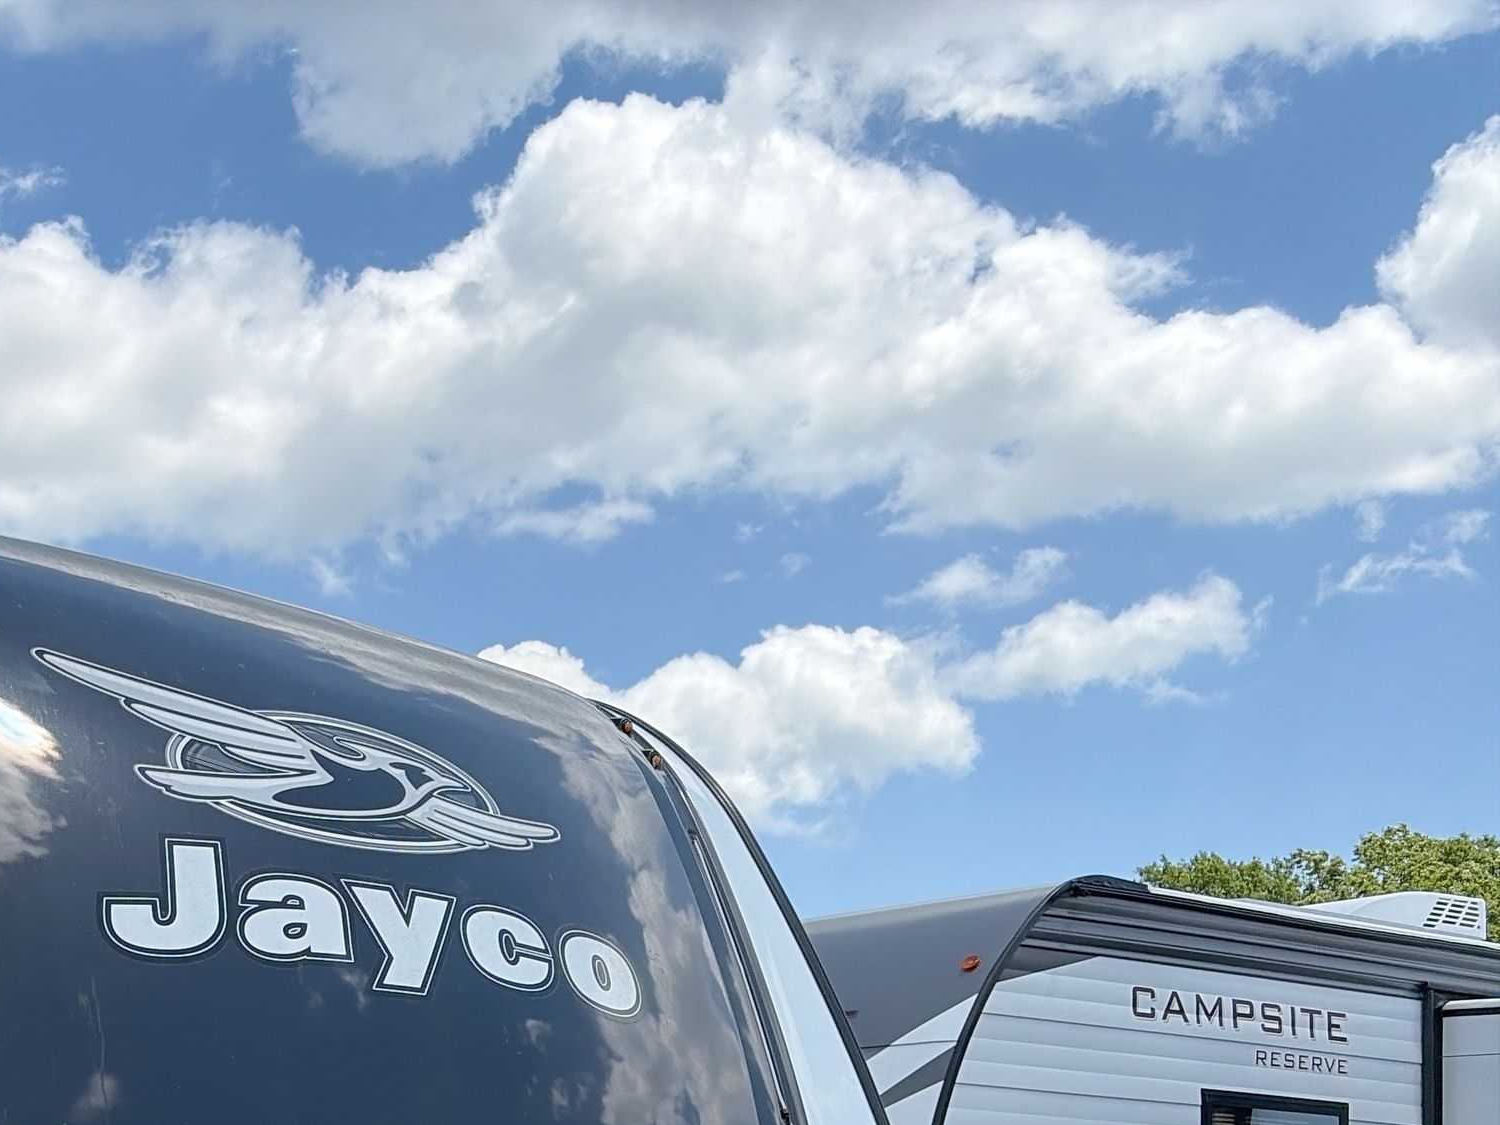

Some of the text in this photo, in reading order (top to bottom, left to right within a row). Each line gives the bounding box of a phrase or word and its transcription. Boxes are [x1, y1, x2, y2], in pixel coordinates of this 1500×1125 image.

[102, 837, 642, 1018] Jayco
[1131, 986, 1349, 1044] CAMPSITE
[1255, 1050, 1349, 1075] RESERVE
